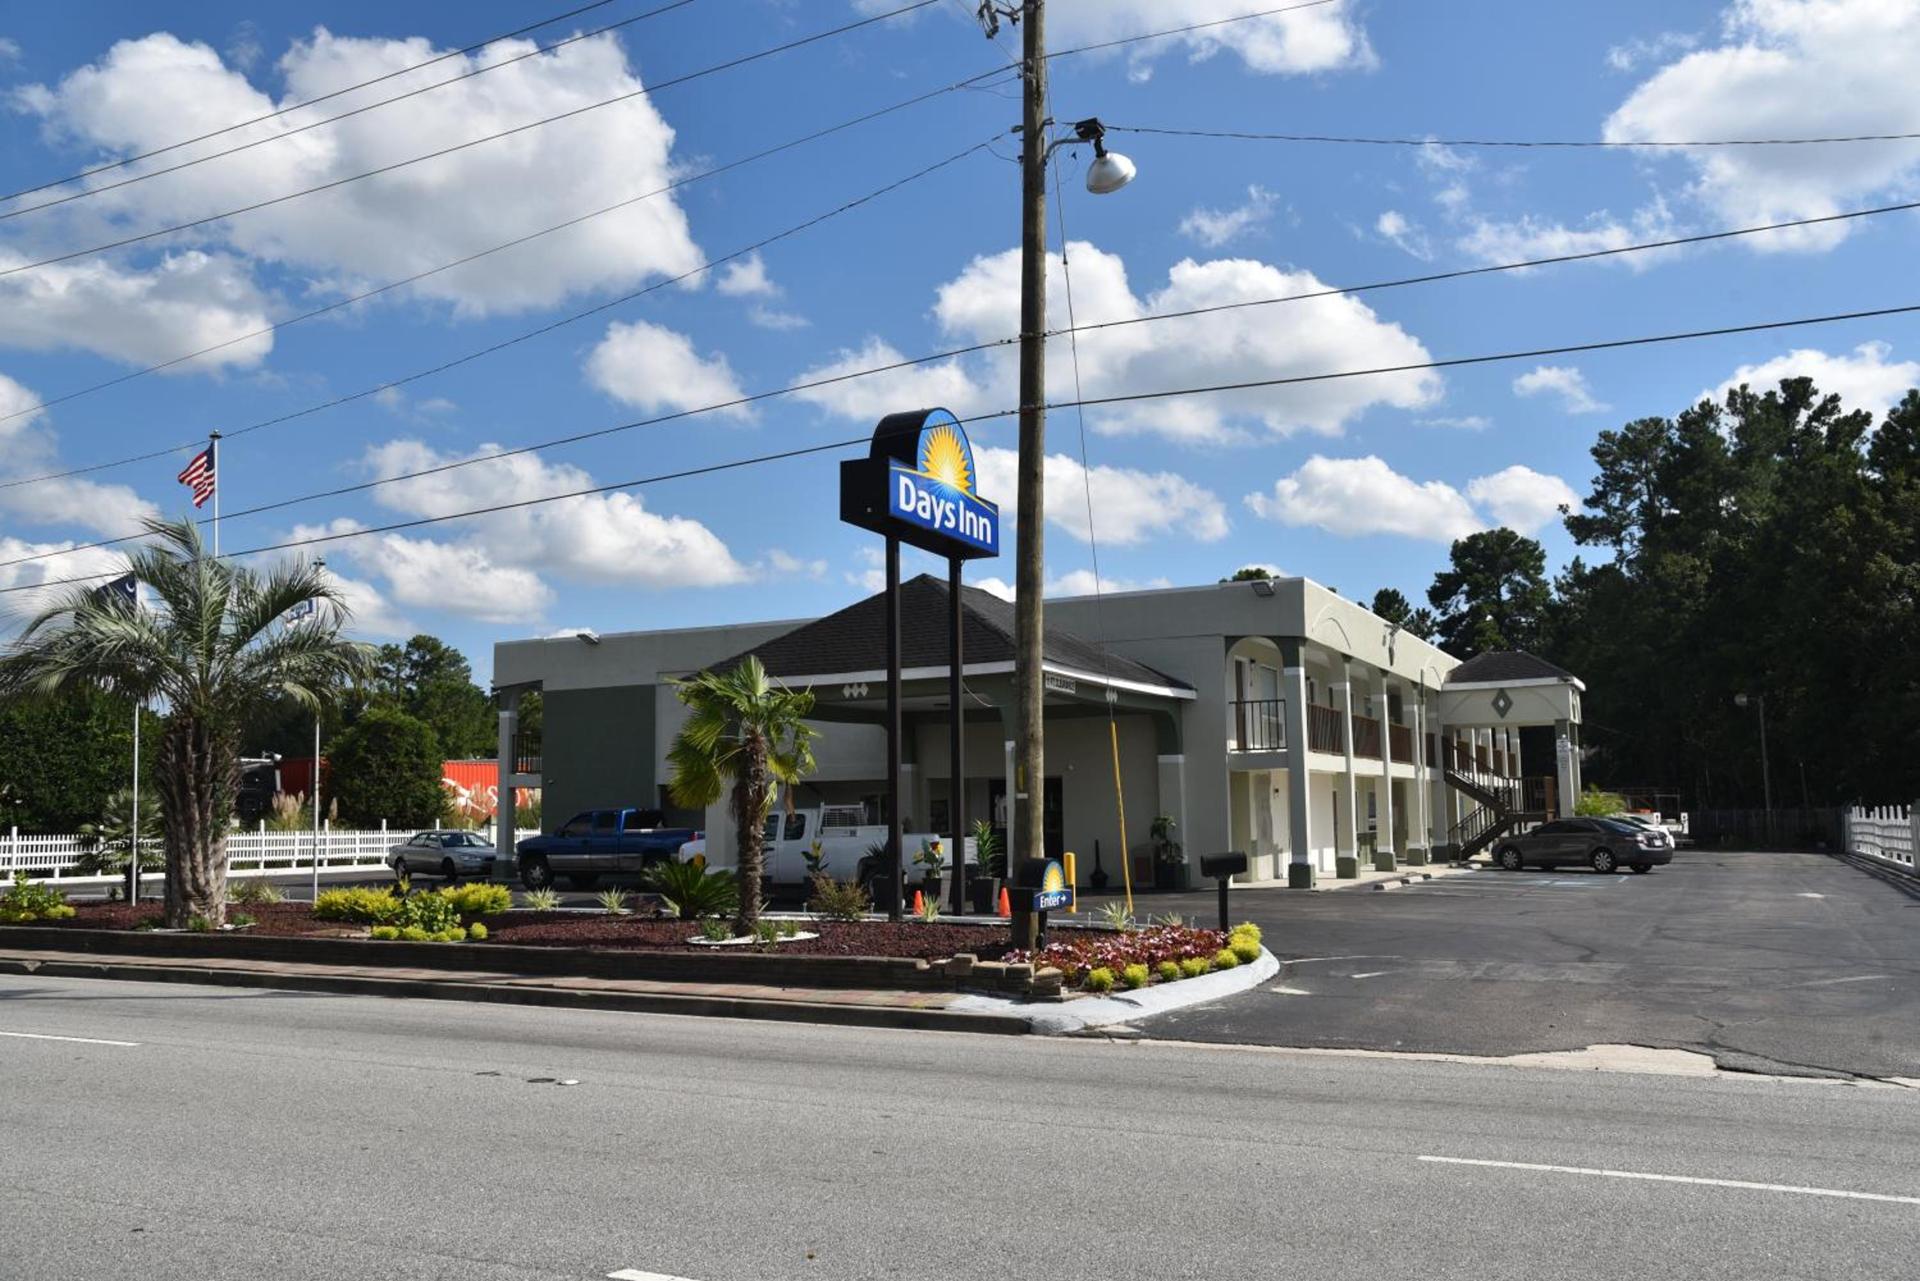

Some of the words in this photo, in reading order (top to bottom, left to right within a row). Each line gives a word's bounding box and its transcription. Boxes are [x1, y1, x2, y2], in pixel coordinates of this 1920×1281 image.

[899, 474, 956, 529] Days
[959, 500, 992, 544] Inn
[1040, 895, 1060, 908] Enter
